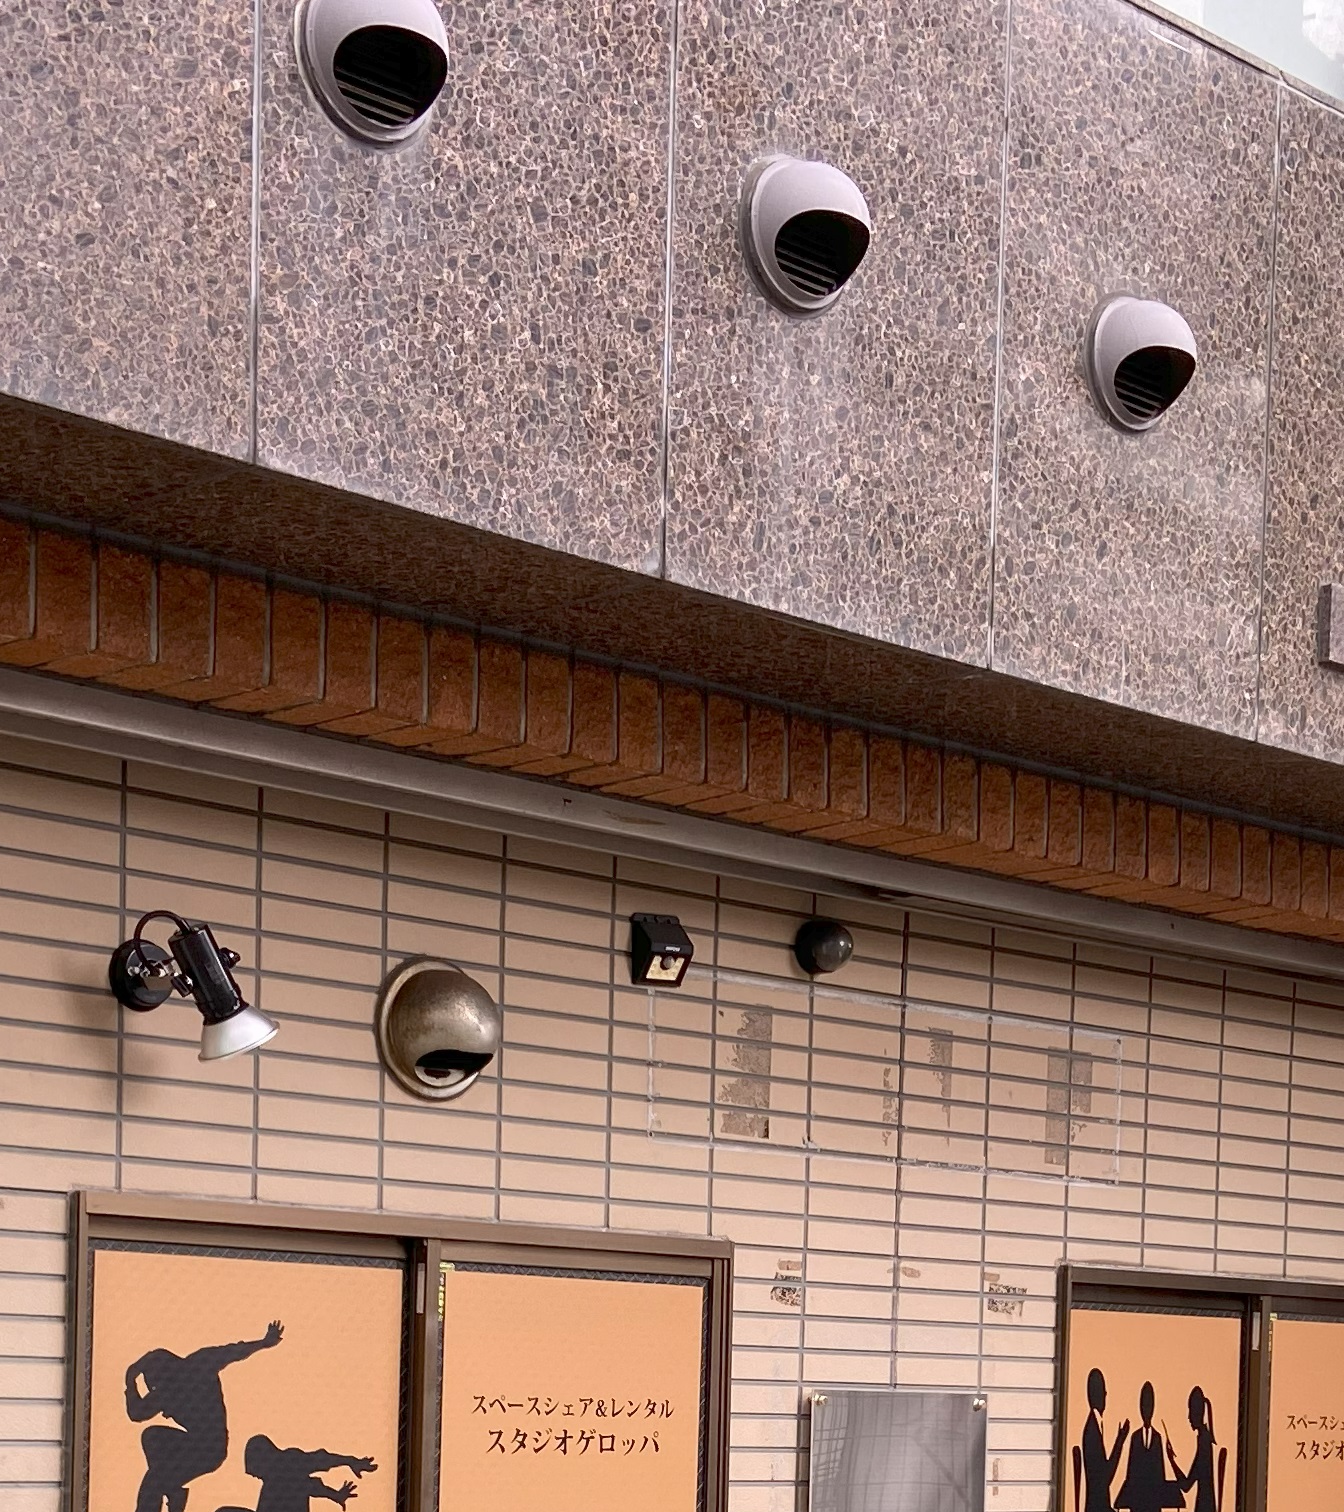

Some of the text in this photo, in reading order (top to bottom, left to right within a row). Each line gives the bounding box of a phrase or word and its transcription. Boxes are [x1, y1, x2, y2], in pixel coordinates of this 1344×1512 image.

[471, 1394, 675, 1419] スペースシェア&レンタル
[486, 1428, 660, 1456] スタジオゲロッパ
